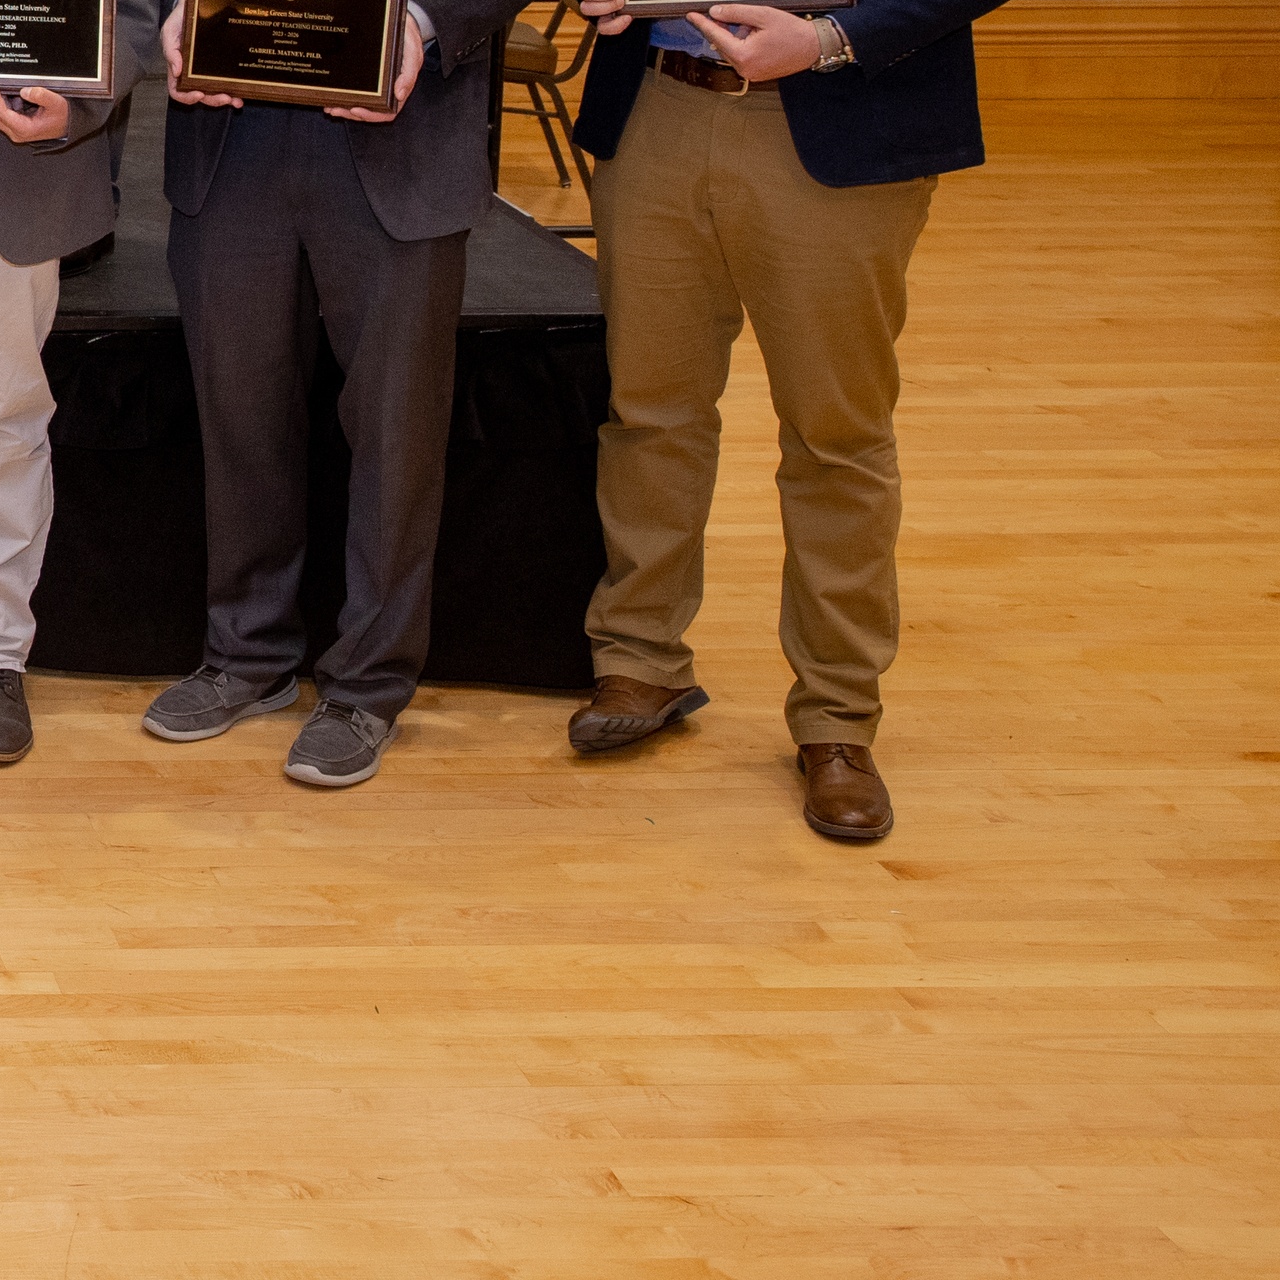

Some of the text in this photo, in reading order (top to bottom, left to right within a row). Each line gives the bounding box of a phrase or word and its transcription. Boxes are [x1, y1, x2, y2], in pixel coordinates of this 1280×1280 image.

[20, 4, 50, 13] University
[244, 7, 269, 17] Bowling
[304, 12, 334, 22] University
[228, 18, 272, 26] PROFESSORSHIP
[311, 25, 348, 33] EXCELLENCE
